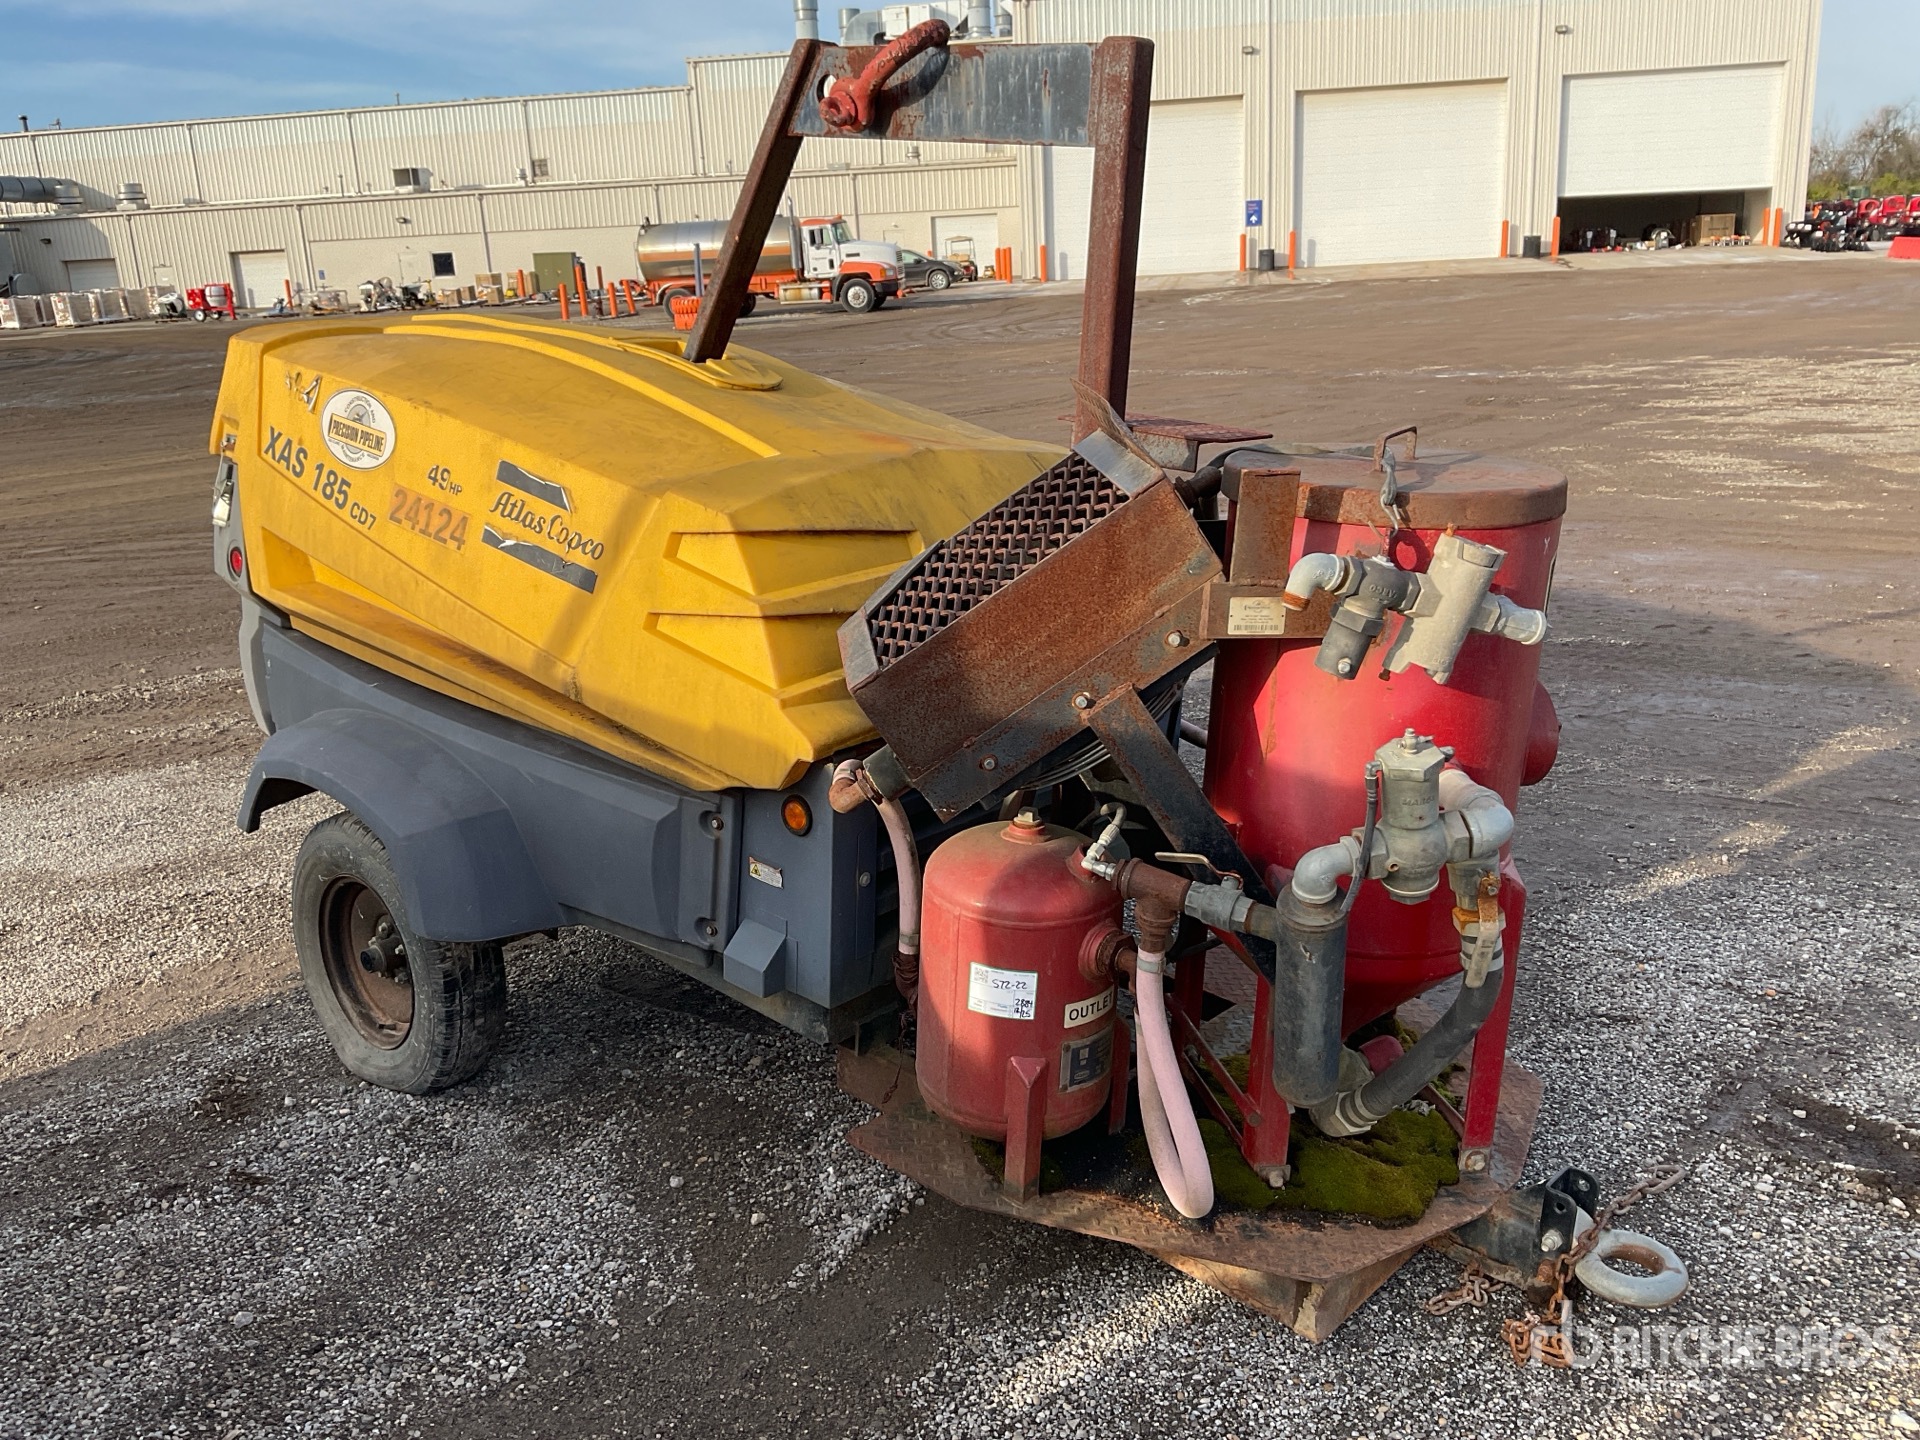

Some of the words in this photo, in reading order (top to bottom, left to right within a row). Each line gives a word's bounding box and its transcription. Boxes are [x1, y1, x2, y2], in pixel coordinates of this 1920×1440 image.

[331, 419, 360, 443] PRECISION
[358, 429, 384, 453] PIPELINE
[264, 426, 308, 478] XAS
[312, 463, 352, 510] 185
[350, 501, 377, 531] CD7
[389, 488, 470, 552] 24124
[489, 491, 547, 534] Atlas
[546, 514, 605, 561] Copco
[1068, 992, 1114, 1021] OUTLET
